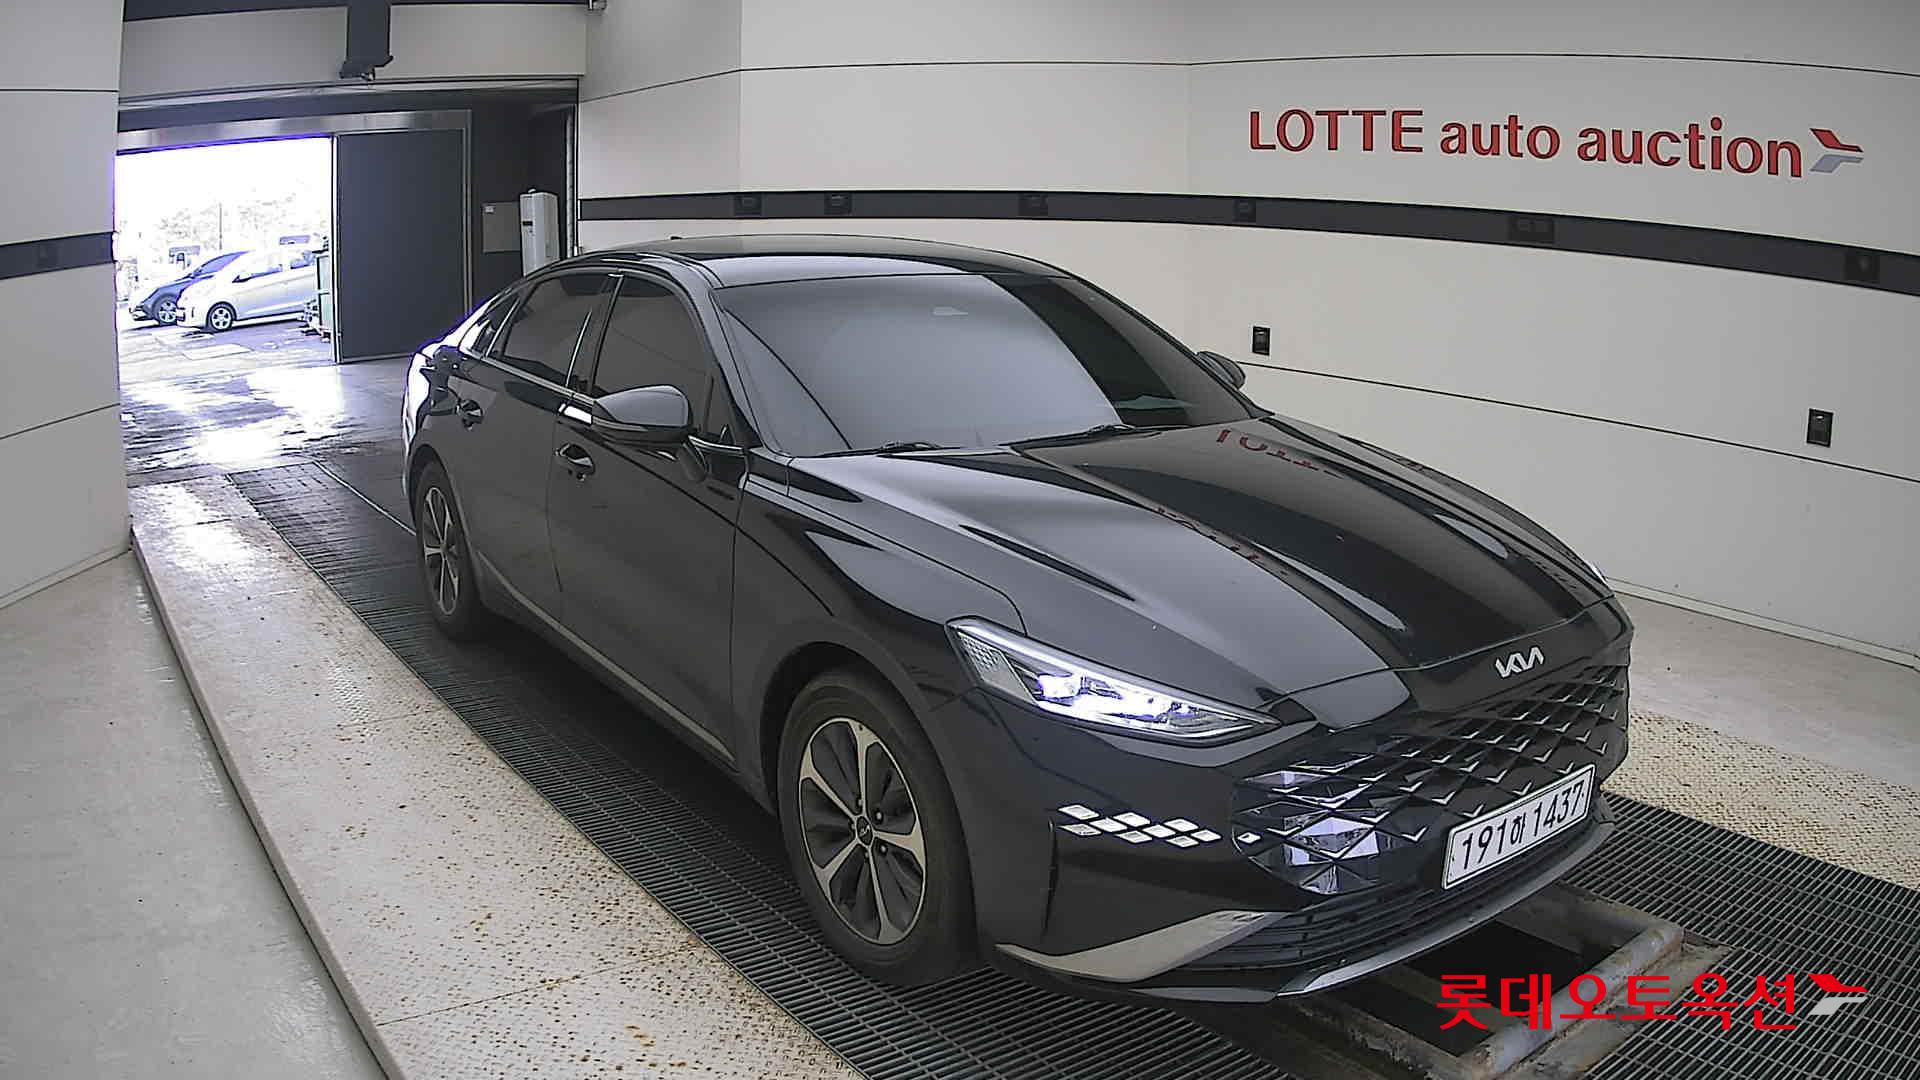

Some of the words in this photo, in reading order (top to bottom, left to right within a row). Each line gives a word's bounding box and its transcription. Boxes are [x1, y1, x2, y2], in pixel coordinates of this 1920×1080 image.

[1249, 109, 1423, 153] LOTTE
[1440, 115, 1560, 159] auto
[1577, 117, 1803, 179] auction
[1495, 646, 1544, 678] KIA
[1462, 813, 1526, 869] 191하
[1533, 779, 1585, 837] 1437
